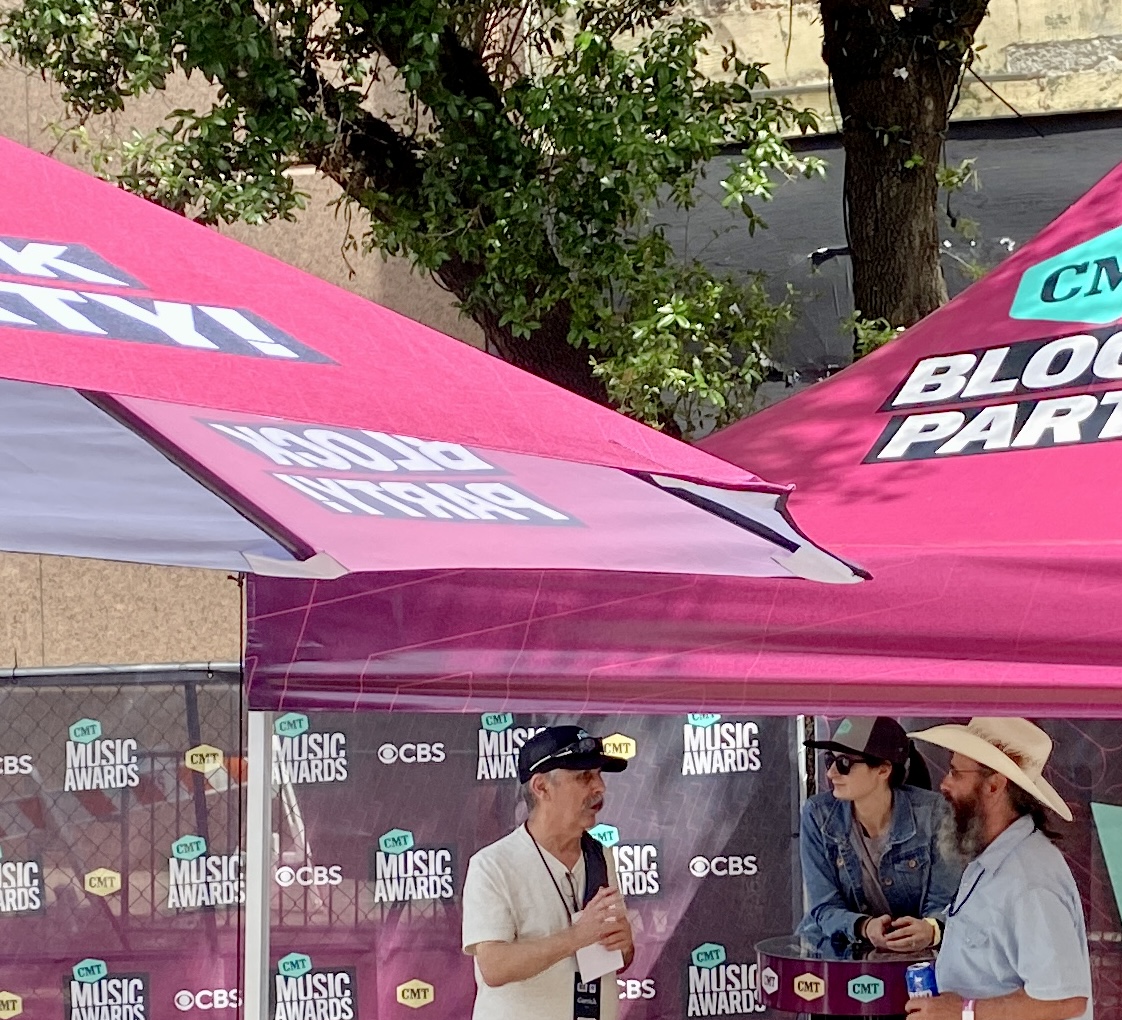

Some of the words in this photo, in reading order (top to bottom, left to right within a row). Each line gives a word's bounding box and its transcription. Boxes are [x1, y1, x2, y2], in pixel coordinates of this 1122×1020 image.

[0, 281, 299, 358] TY!
[278, 718, 305, 732] CMT
[485, 713, 508, 726] CMT
[73, 724, 98, 738] CMT
[683, 721, 760, 752] MUSIC
[271, 731, 347, 762] MUSIC
[399, 742, 446, 763] CBS
[478, 727, 547, 757] MUS
[603, 743, 631, 755] CMT
[65, 739, 137, 769] MUSIC
[190, 752, 219, 766] CMT
[682, 746, 762, 776] AWARDS
[64, 764, 140, 792] AWARDS
[270, 756, 348, 785] AWARDS
[383, 834, 410, 847] CMT
[592, 831, 614, 842] MT
[176, 841, 202, 854] CMT
[168, 854, 244, 884] MUSIC
[375, 849, 452, 879] MUSIC
[612, 845, 658, 872] SIC
[709, 855, 758, 876] CBS
[0, 861, 39, 889] SIC
[88, 876, 117, 889] CMT
[295, 864, 343, 886] CBS
[616, 870, 660, 896] RDS
[0, 885, 41, 912] RDS
[168, 876, 246, 909] AWARDS
[373, 874, 453, 903] AWARDS
[281, 957, 308, 972] CMT
[696, 949, 721, 963] CMT
[76, 964, 102, 978] CMT
[688, 963, 758, 994] MUSIC
[763, 975, 776, 987] CMT
[70, 978, 144, 1009] MUSIC
[275, 972, 351, 1001] MUSIC
[401, 987, 429, 1000] CMT
[797, 980, 821, 994] CMT
[852, 982, 880, 995] CMT
[0, 999, 18, 1011] MT
[194, 988, 243, 1009] CBS
